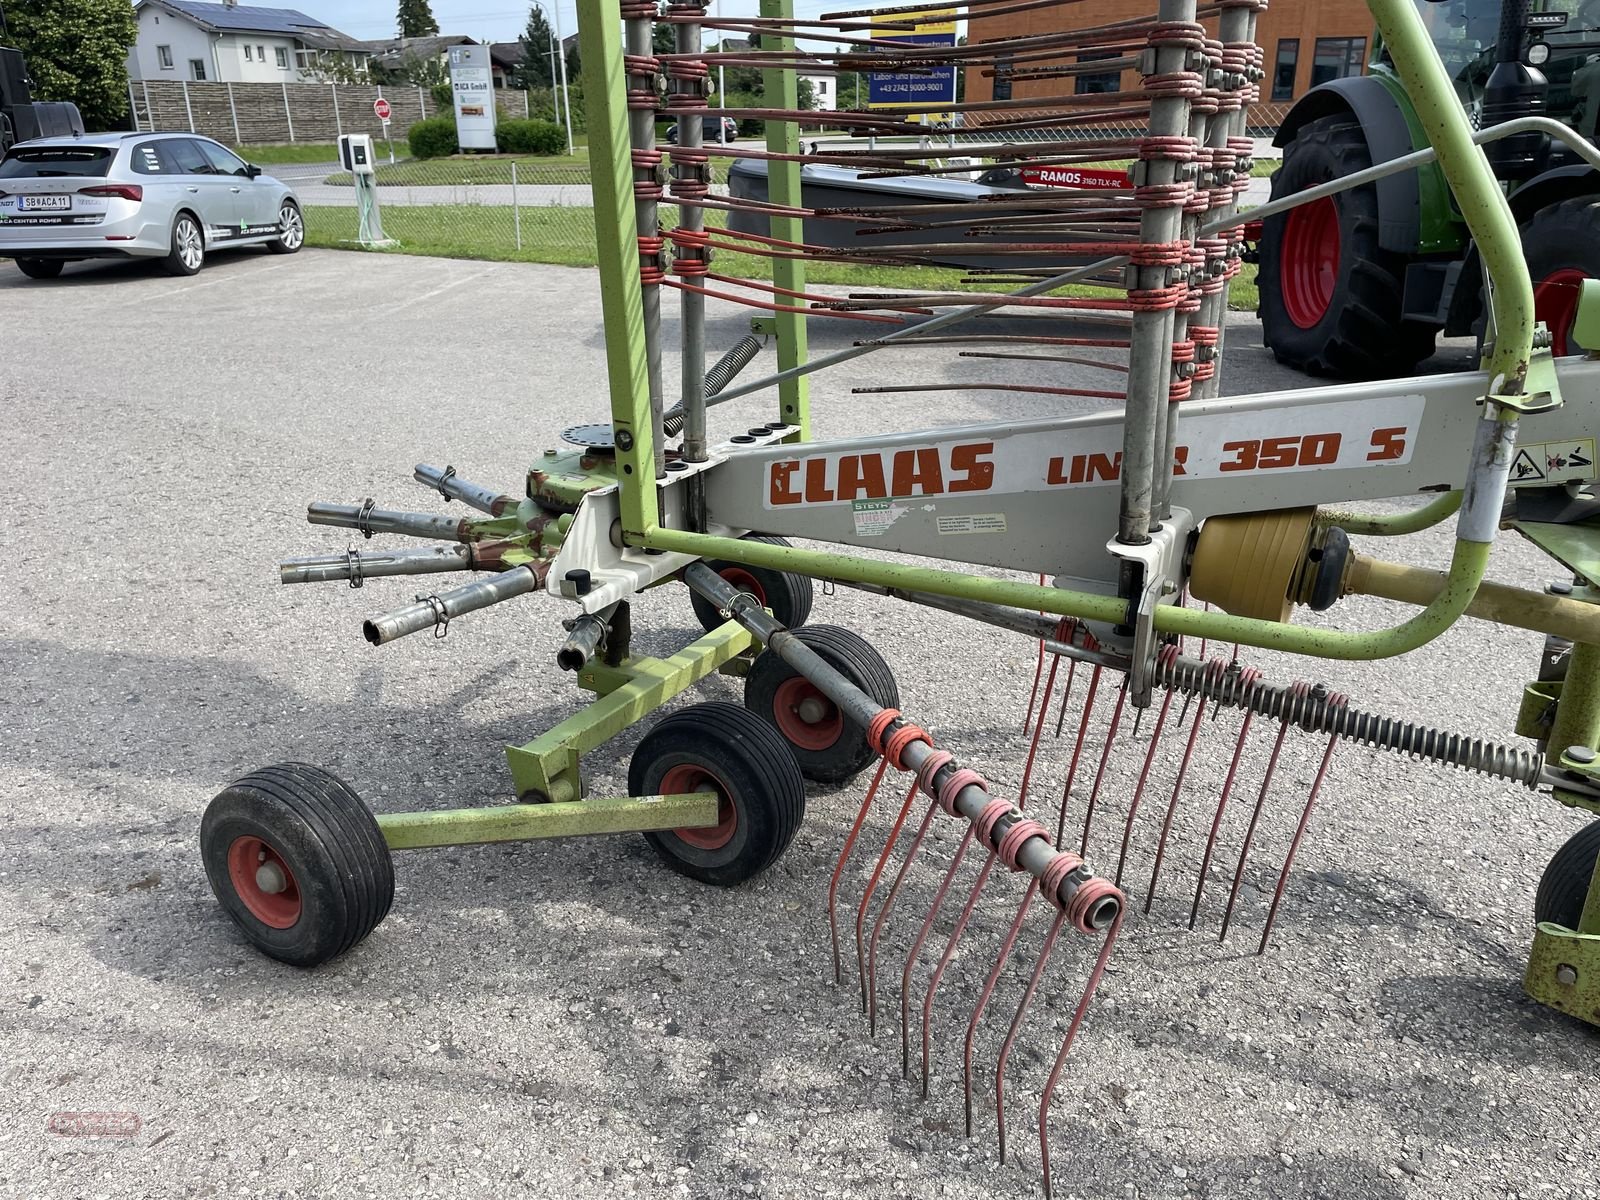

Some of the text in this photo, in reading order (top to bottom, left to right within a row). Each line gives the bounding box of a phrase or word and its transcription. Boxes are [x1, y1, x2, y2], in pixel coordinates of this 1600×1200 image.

[880, 82, 943, 92] +43 2742 9000-9001
[376, 105, 389, 114] STOP
[1040, 170, 1122, 188] RAMOS 3160 TLX-RC
[26, 198, 36, 207] SB
[41, 197, 57, 207] ACA
[58, 197, 66, 206] 11
[1046, 426, 1408, 485] LINR 350 S
[769, 442, 995, 505] CLAAS
[855, 501, 889, 510] STEYR
